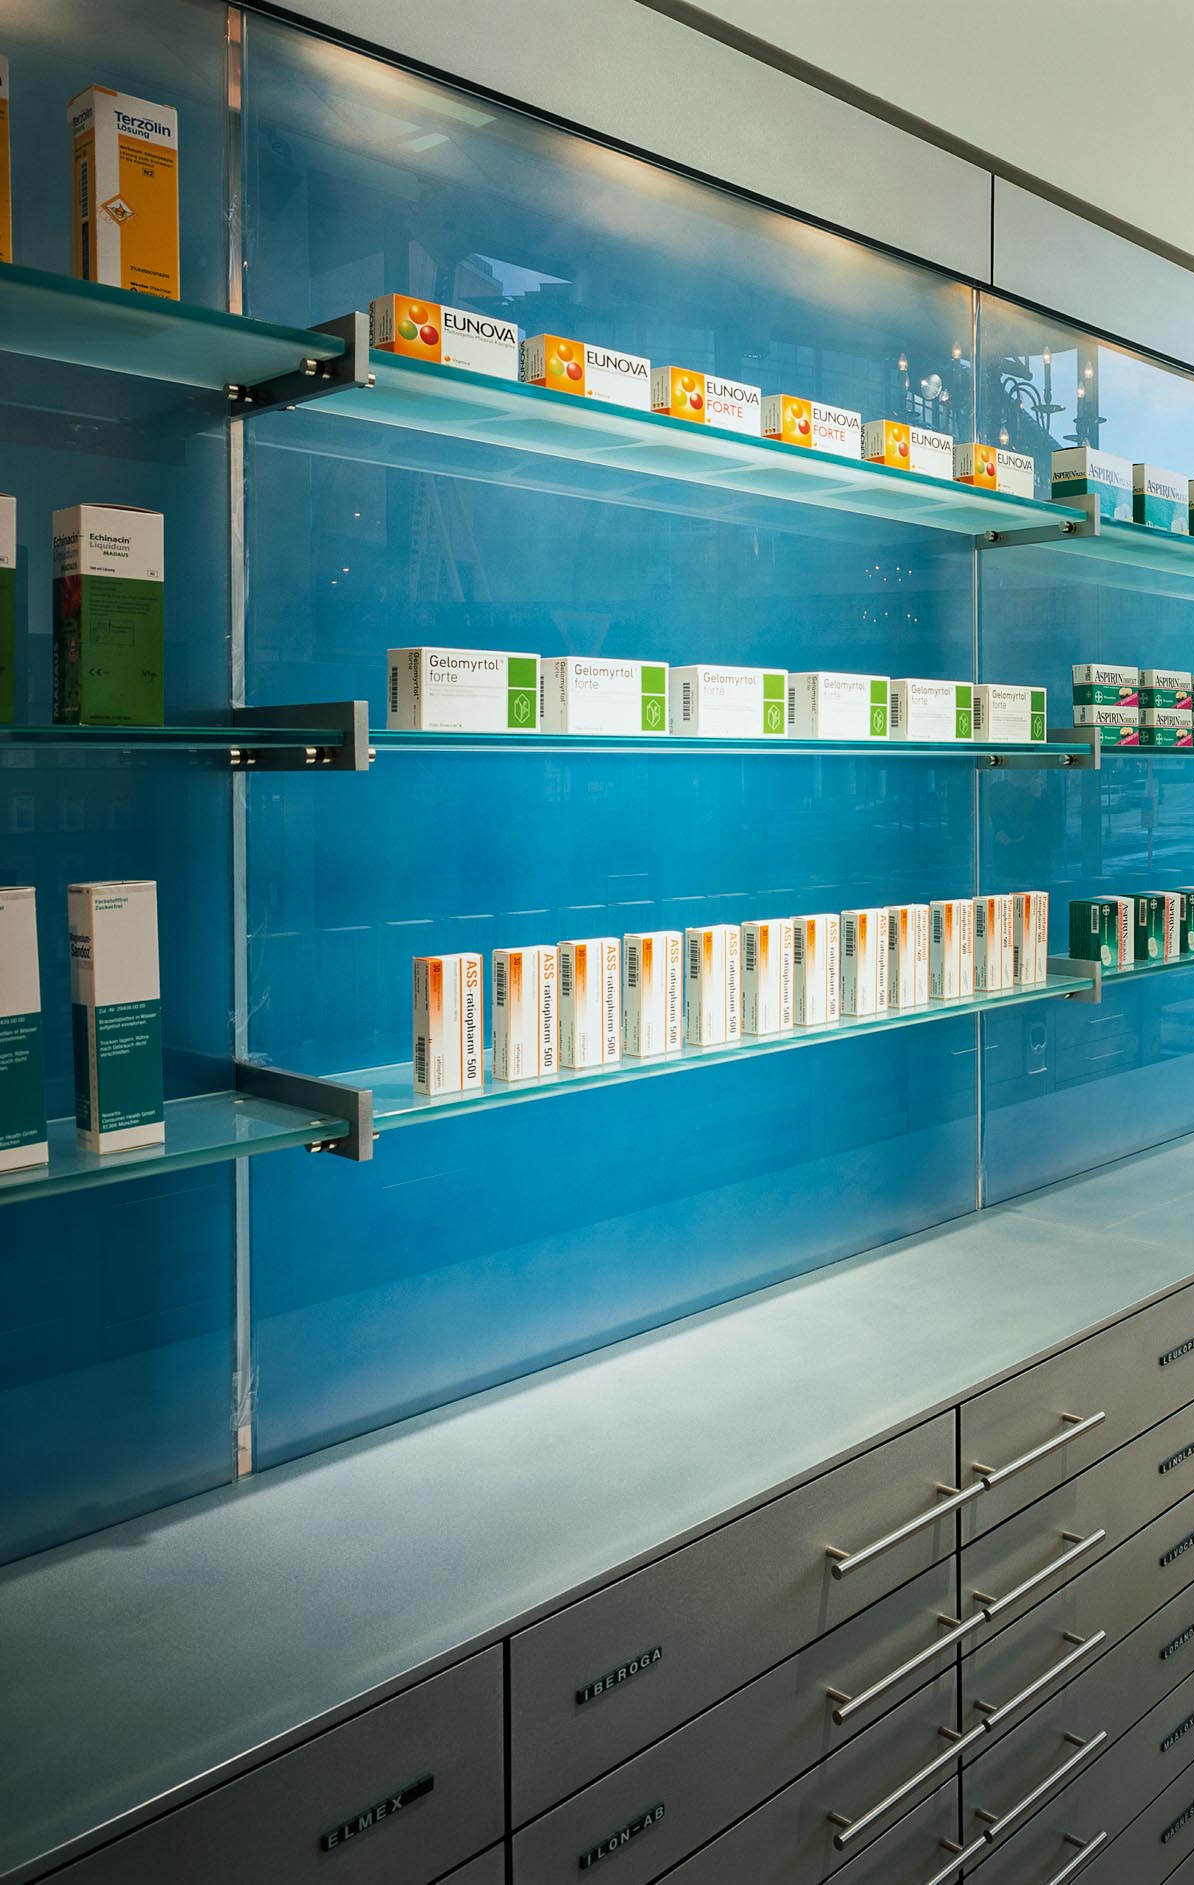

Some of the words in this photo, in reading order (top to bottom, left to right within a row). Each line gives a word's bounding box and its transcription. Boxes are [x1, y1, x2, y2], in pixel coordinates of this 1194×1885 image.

[114, 110, 171, 137] Terzolin
[444, 312, 515, 344] EUNOVA
[587, 351, 648, 378] EUNOVA
[707, 381, 759, 406] EUNOVA
[707, 400, 743, 419] FORTE
[813, 408, 860, 430] EUNOVA
[813, 425, 845, 442] FORTE
[911, 432, 951, 453] EUNOVA
[997, 453, 1033, 472] EUNOVA
[1089, 464, 1119, 483] ASPIRIN
[1147, 480, 1175, 498] ASPIRIN
[89, 533, 131, 544] Echinacin
[89, 541, 130, 551] Liquidum
[429, 654, 499, 673] Gelomyrtol
[575, 663, 634, 680] Gelomyrtol
[429, 669, 458, 683] forte
[575, 678, 599, 690] forte
[703, 671, 756, 686] Gelomyrtol
[824, 678, 865, 692] Gelomyrtol
[1095, 670, 1123, 684] ASPIRIN
[1156, 675, 1179, 689] ASPIRIN
[911, 684, 951, 697] Gelomyrtol
[992, 689, 1027, 702] Gelomyrtol
[1096, 710, 1124, 725] ASPIRIN
[1156, 713, 1180, 726] ASPIRIN
[671, 938, 679, 964] ASS
[433, 963, 441, 973] 30
[513, 956, 521, 966] 30
[669, 1027, 677, 1044] 500
[607, 1035, 616, 1055] 500
[543, 1046, 553, 1067] 500
[466, 1057, 477, 1079] 500
[584, 1647, 662, 1702] IBEROGA
[327, 1796, 403, 1850] ELMEX
[587, 1805, 665, 1866] ILON-AB
